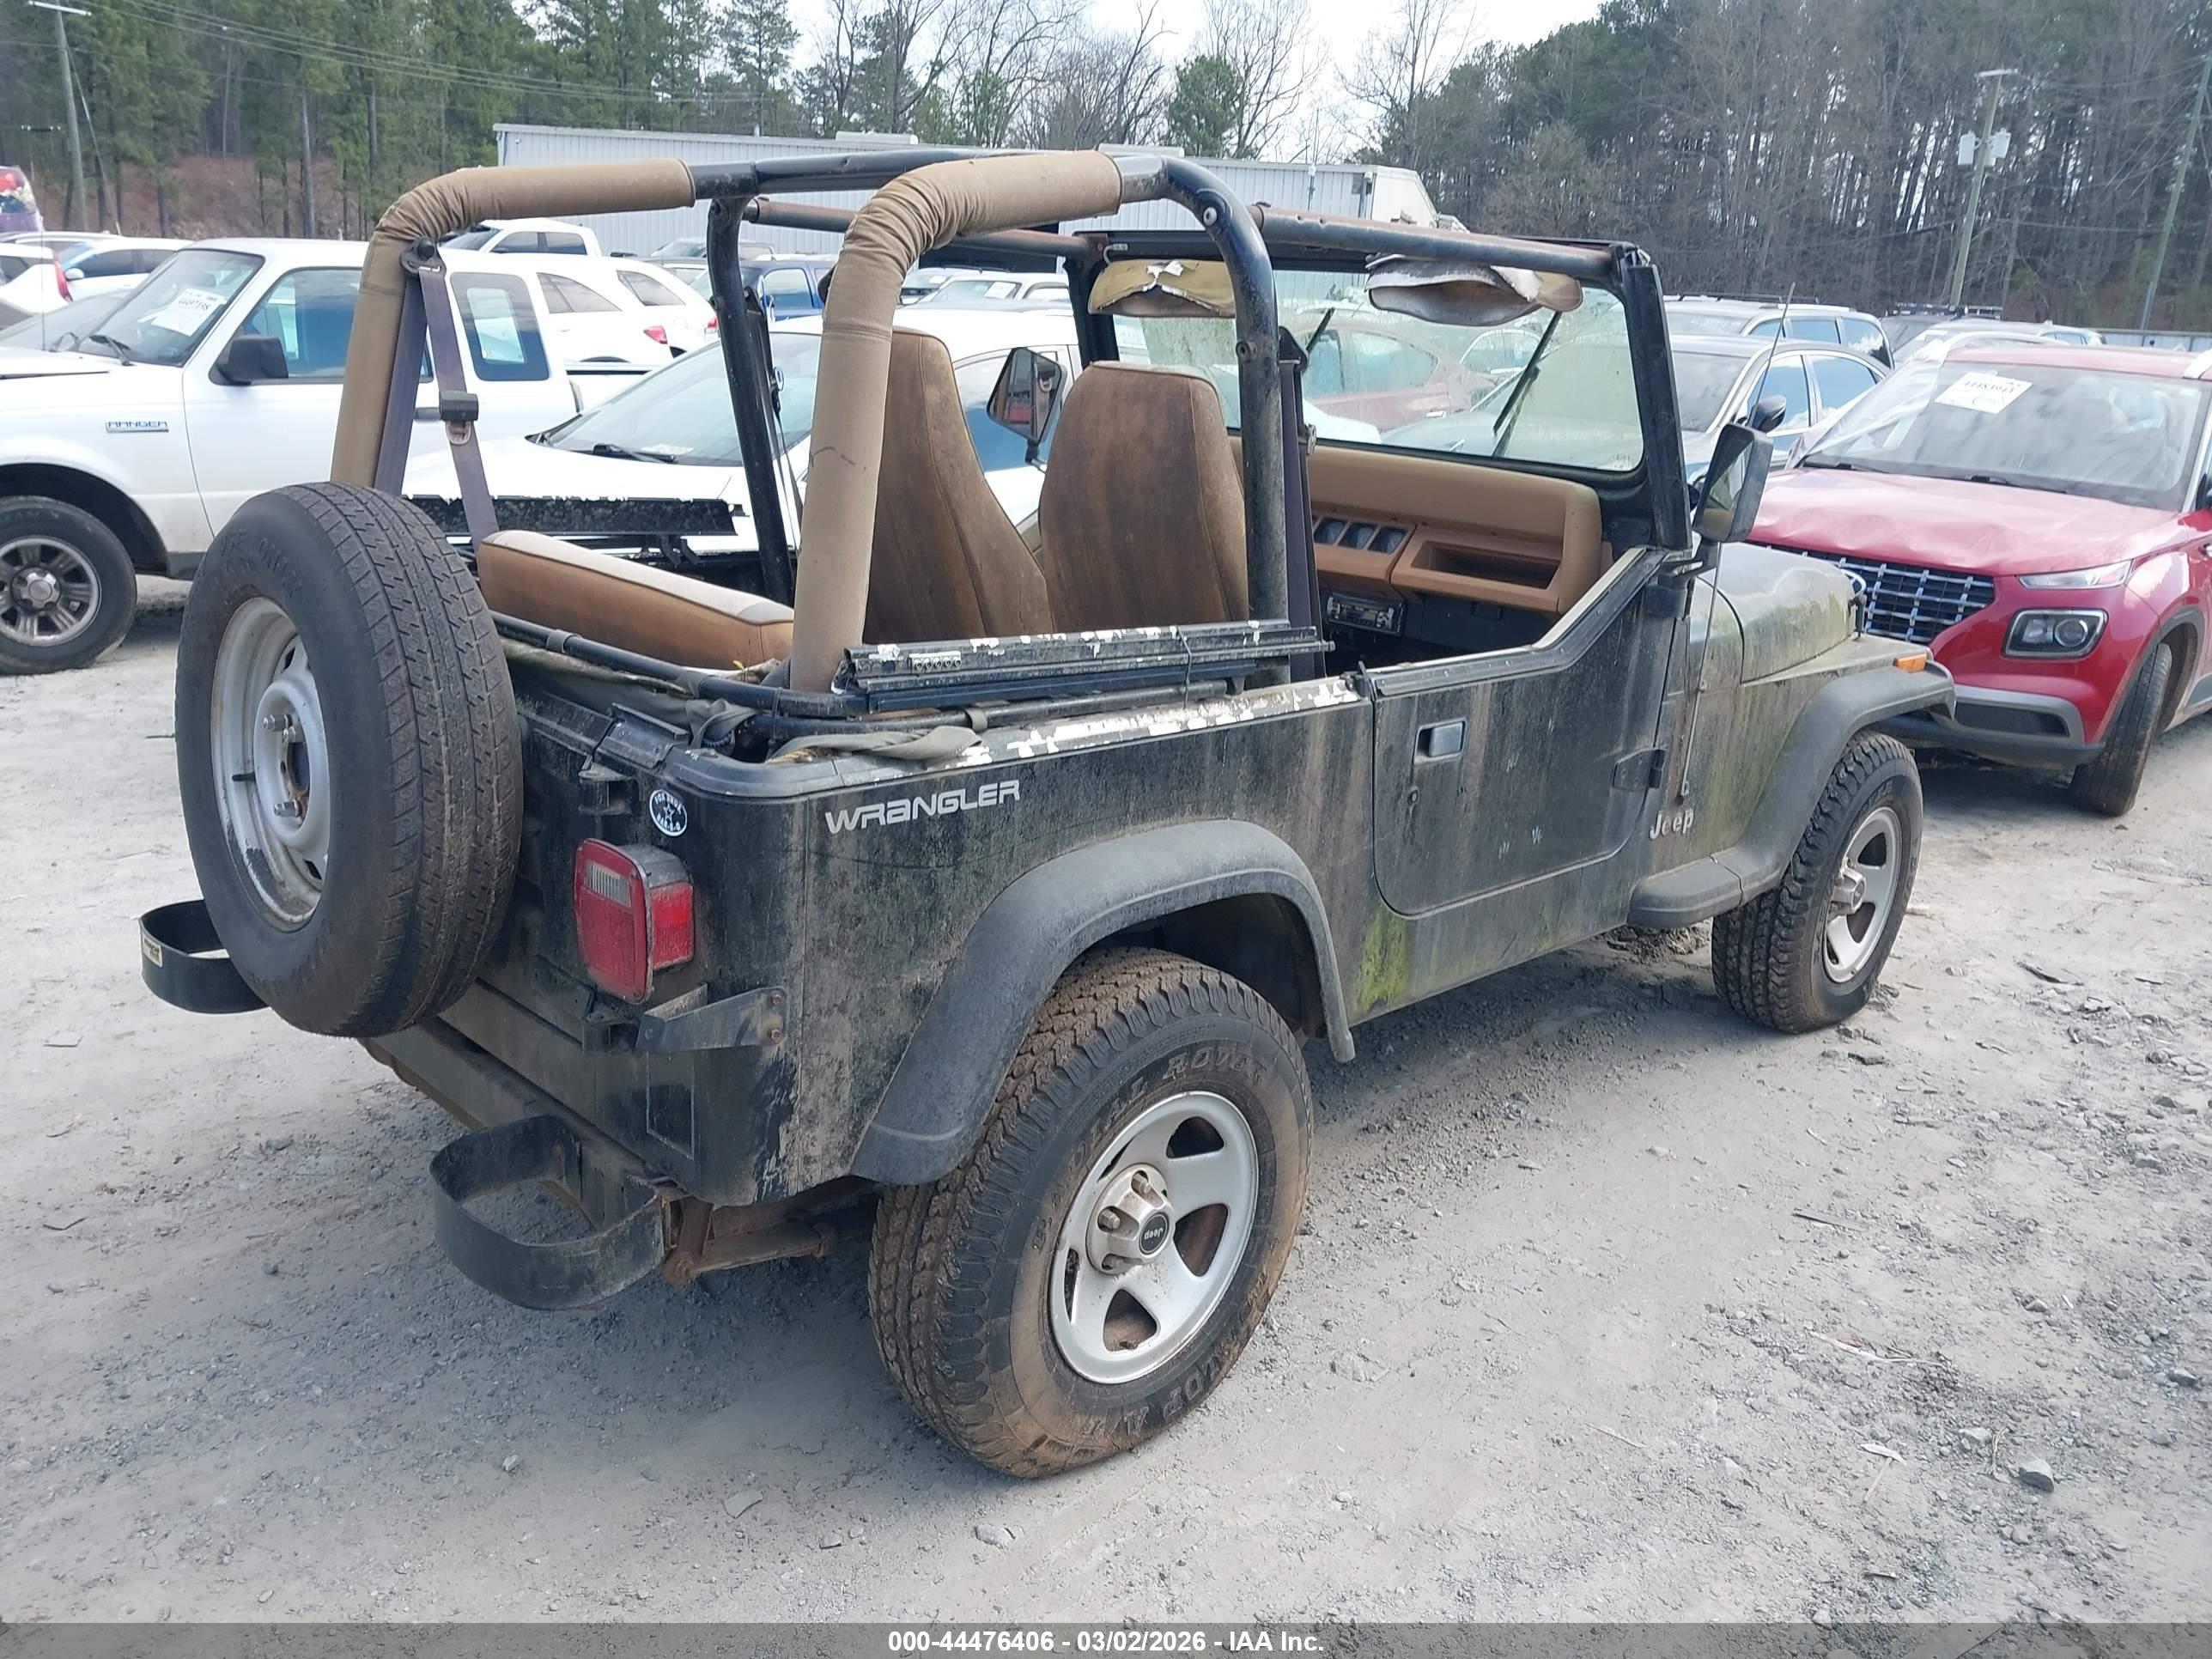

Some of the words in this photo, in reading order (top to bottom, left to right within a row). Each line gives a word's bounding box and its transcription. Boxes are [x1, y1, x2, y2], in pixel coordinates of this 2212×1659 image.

[107, 421, 168, 429] RANGER
[825, 779, 1021, 835] WRANGLER
[1649, 808, 1694, 841] Jeep
[1144, 1227, 1164, 1240] Jeep
